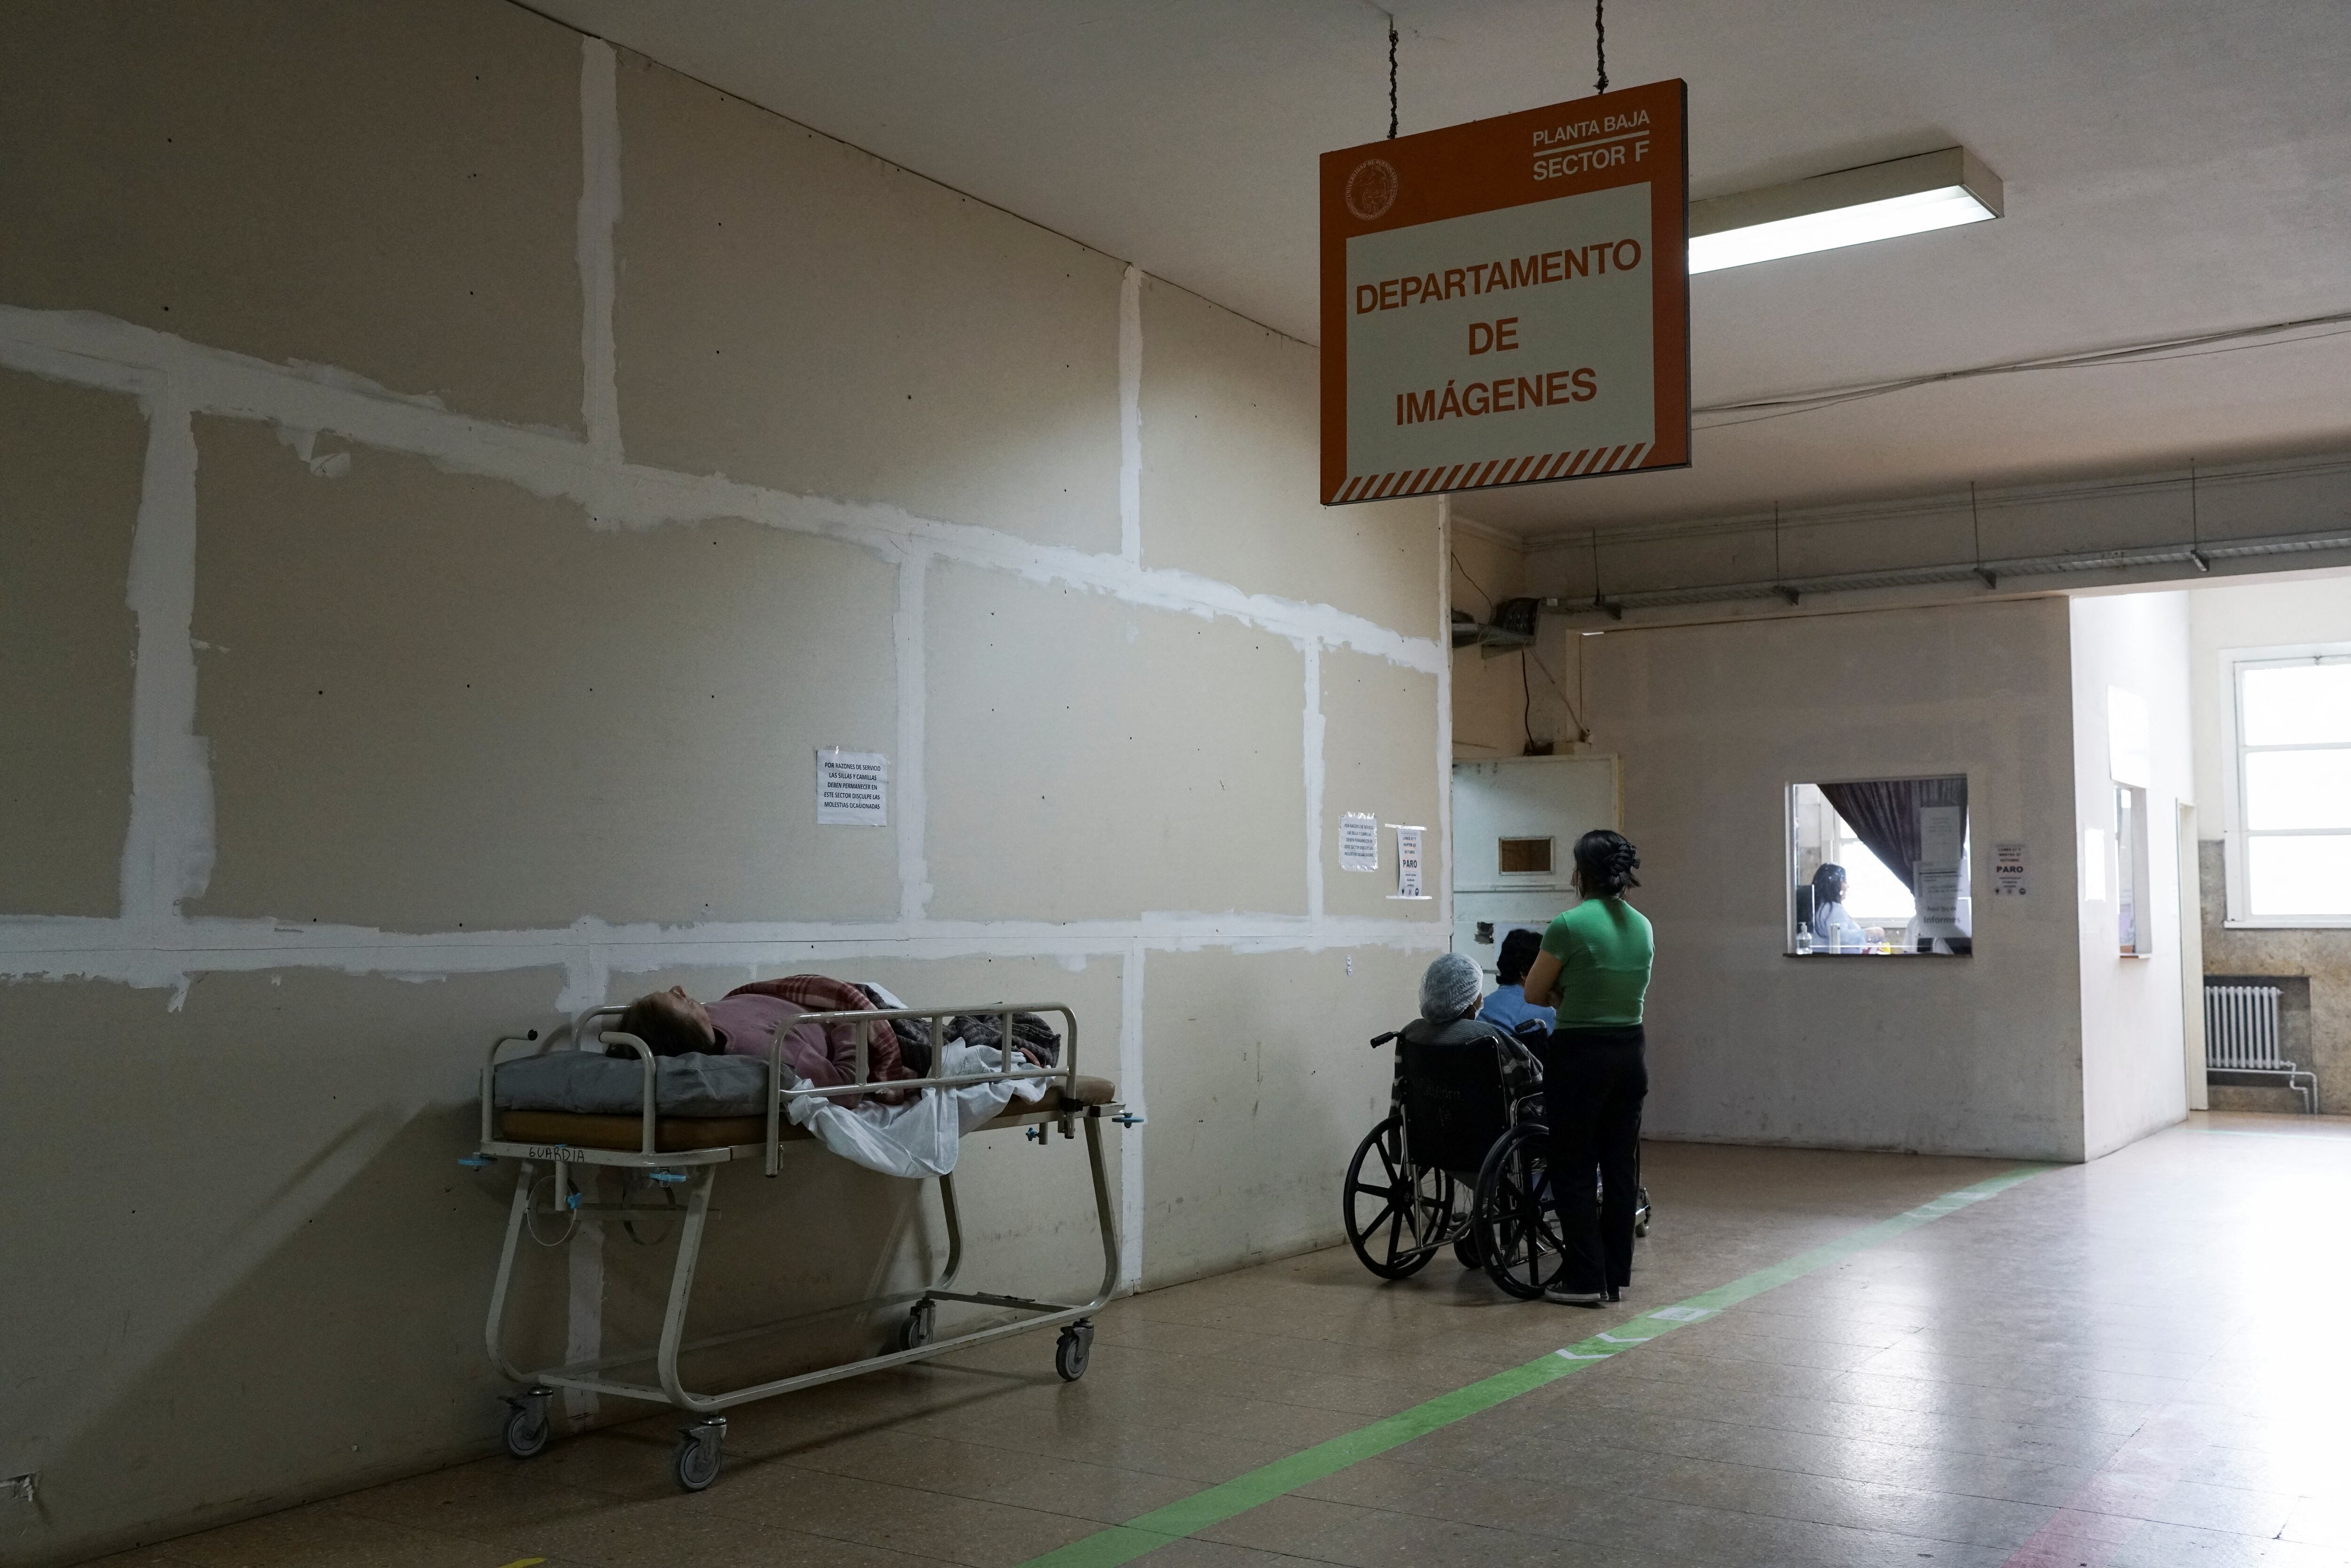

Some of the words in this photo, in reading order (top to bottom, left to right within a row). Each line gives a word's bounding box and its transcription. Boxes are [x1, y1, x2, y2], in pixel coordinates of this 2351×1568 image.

[1533, 118, 1599, 146] PLANTA
[1603, 110, 1650, 132] BAJA
[1533, 148, 1625, 181] SECTOR
[1636, 140, 1649, 162] F
[1346, 163, 1367, 198] UNIVERSIDAD
[1357, 239, 1641, 315] DEPARTAMENTO
[1469, 317, 1519, 356] DE
[1397, 368, 1597, 426] IMÁGENES
[1403, 859, 1417, 868] PARO
[529, 1147, 584, 1163] GUARDIA
